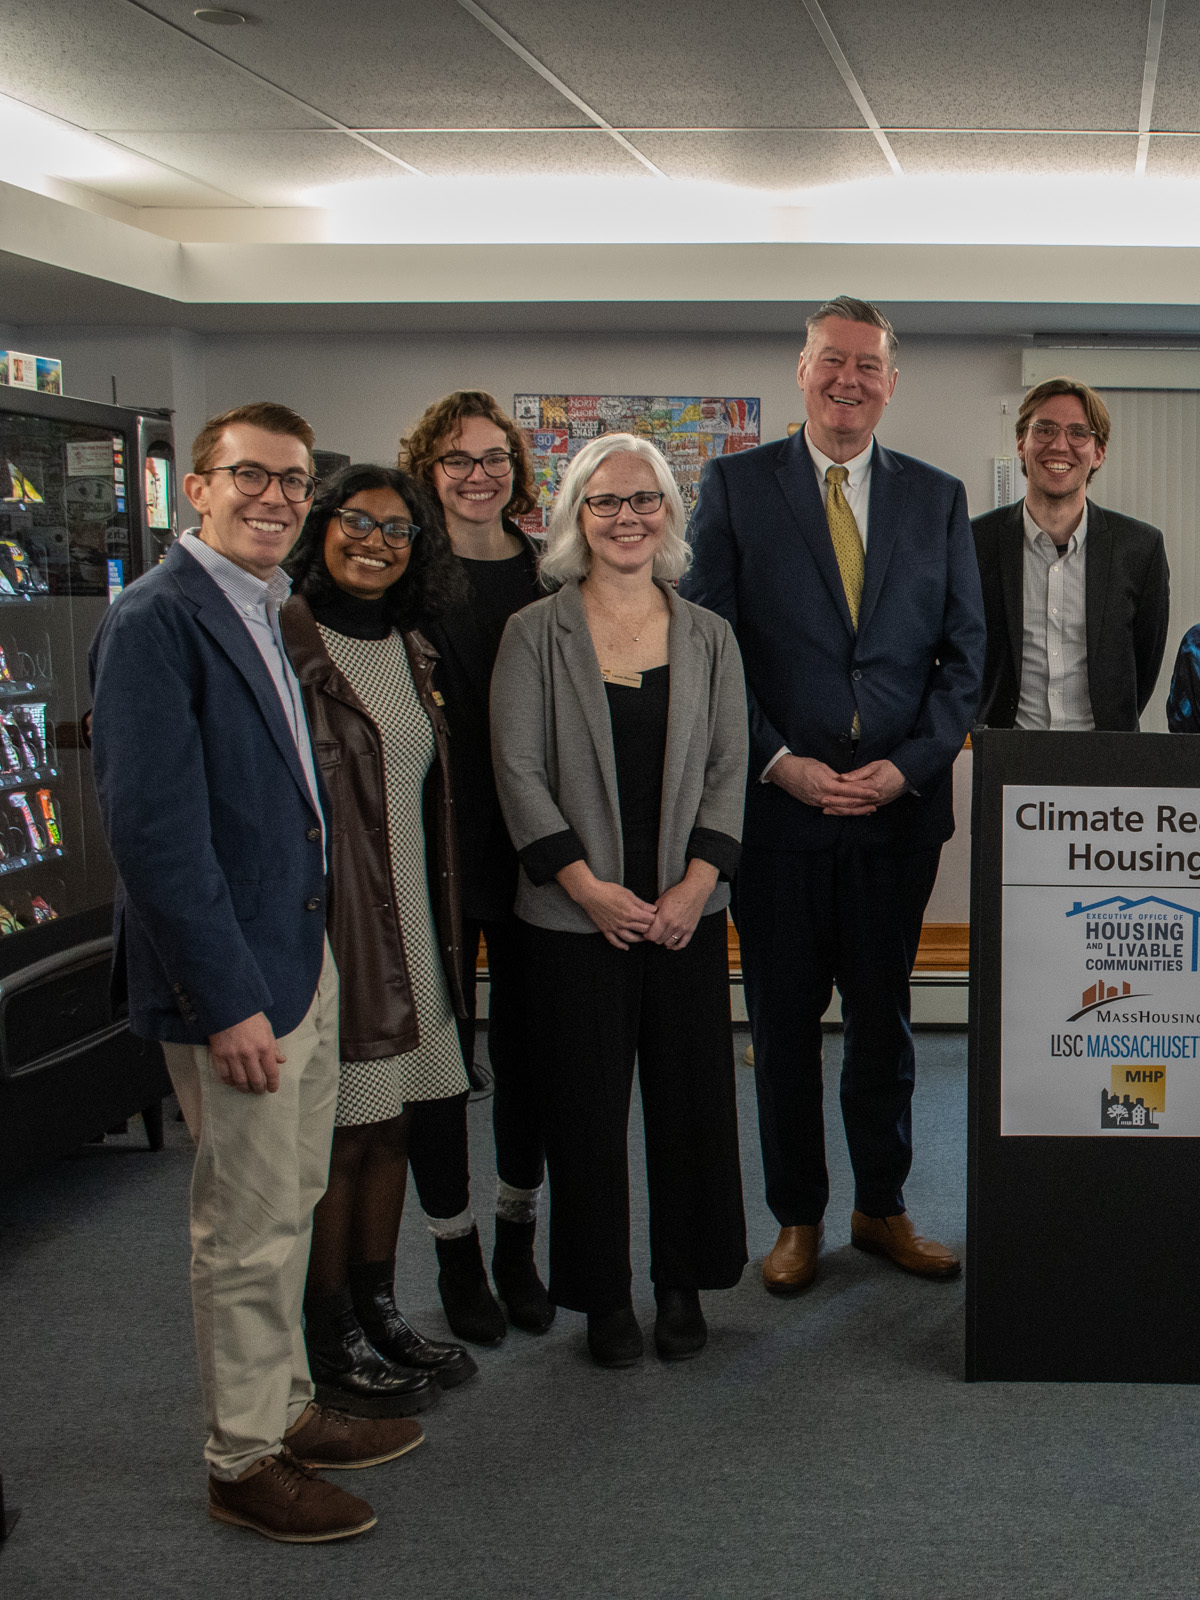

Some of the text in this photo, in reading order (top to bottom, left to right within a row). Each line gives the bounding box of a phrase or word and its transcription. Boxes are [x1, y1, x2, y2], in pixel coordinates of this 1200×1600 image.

[572, 428, 598, 437] SMART
[537, 435, 552, 446] 90
[1015, 801, 1144, 832] Climate
[1086, 922, 1184, 941] HOUSING
[1086, 942, 1184, 957] AND LIVABLE
[1085, 959, 1183, 971] COMMUNITIES
[1051, 1034, 1083, 1057] LISC
[1125, 1070, 1164, 1083] MHP
